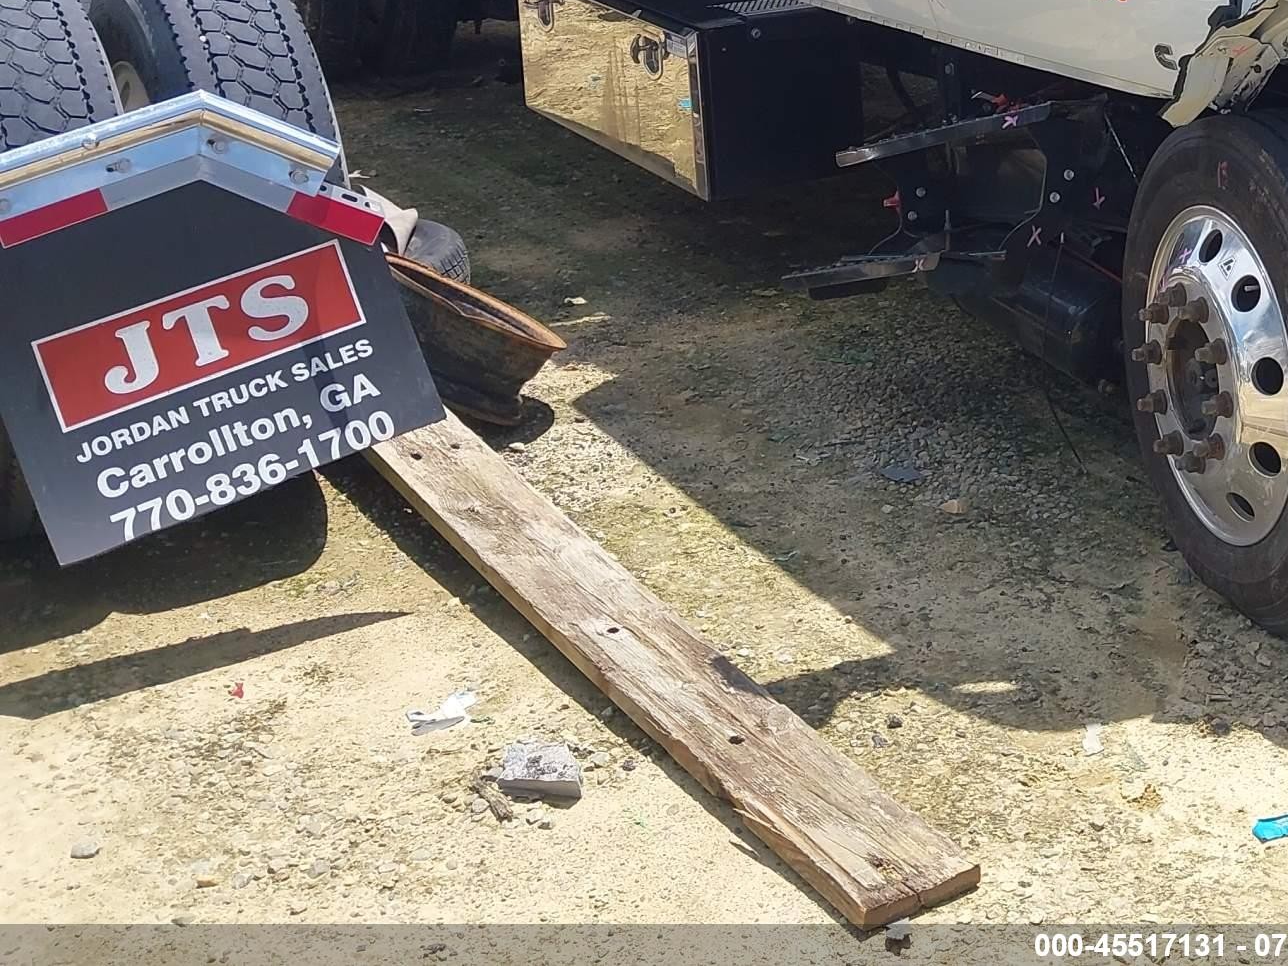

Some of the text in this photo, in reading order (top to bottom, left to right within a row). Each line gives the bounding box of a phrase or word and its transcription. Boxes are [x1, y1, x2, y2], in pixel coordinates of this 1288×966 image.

[104, 275, 309, 395] JTS
[76, 339, 374, 463] JORDAN TRUCK SALES
[96, 374, 381, 499] Carrollton, GA
[110, 410, 395, 542] 770-836-1700
